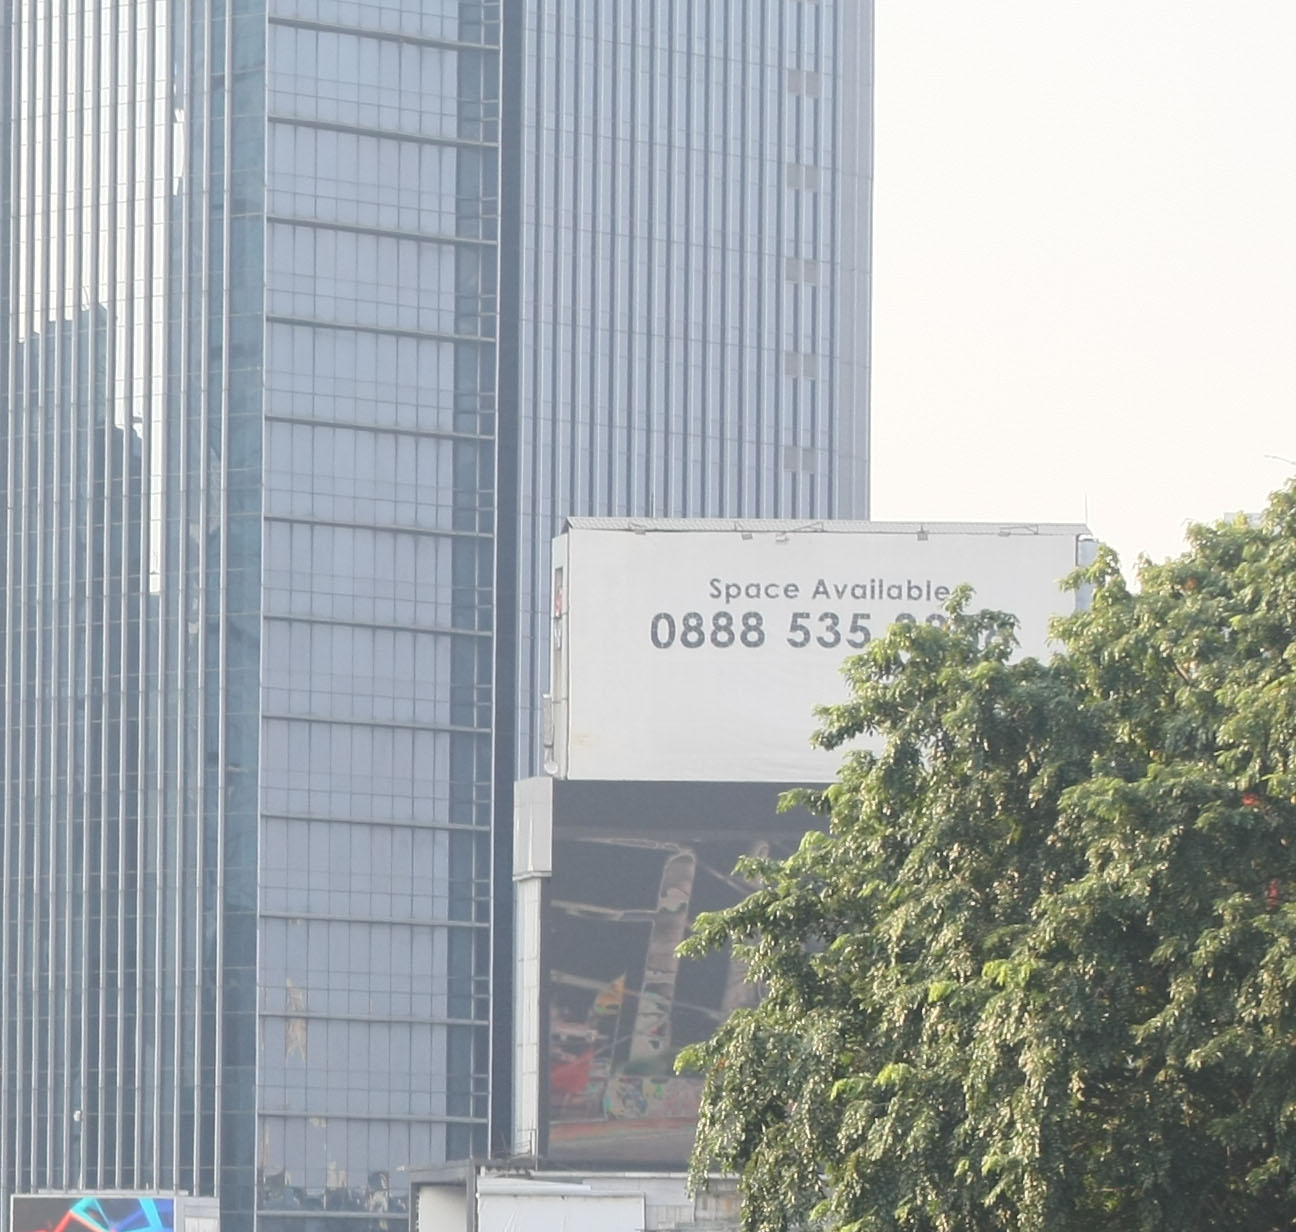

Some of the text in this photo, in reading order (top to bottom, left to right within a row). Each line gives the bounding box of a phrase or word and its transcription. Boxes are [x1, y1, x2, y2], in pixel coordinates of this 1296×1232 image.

[709, 578, 950, 603] Space Available
[650, 611, 766, 649] 0888
[786, 611, 872, 649] 535
